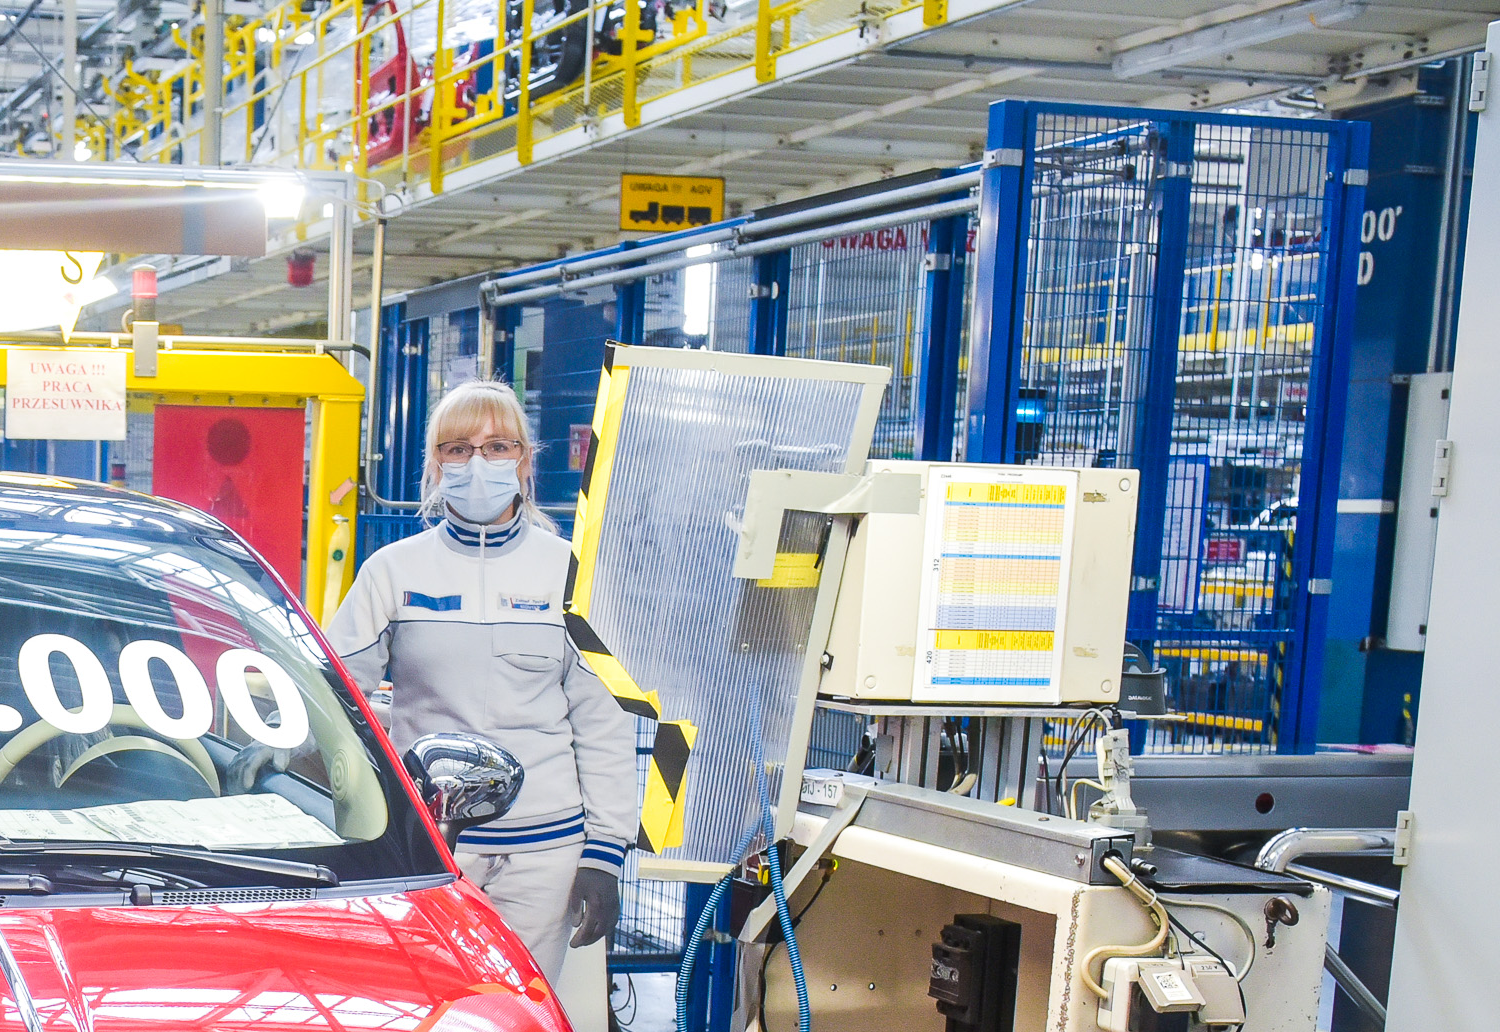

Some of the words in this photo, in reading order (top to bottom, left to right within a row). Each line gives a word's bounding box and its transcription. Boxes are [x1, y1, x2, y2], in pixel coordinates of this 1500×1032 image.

[30, 362, 87, 376] UWAGA
[92, 364, 105, 376] !!!
[43, 380, 93, 393] PRACA
[12, 397, 122, 411] PRZESUWNIKA
[823, 783, 837, 799] 157
